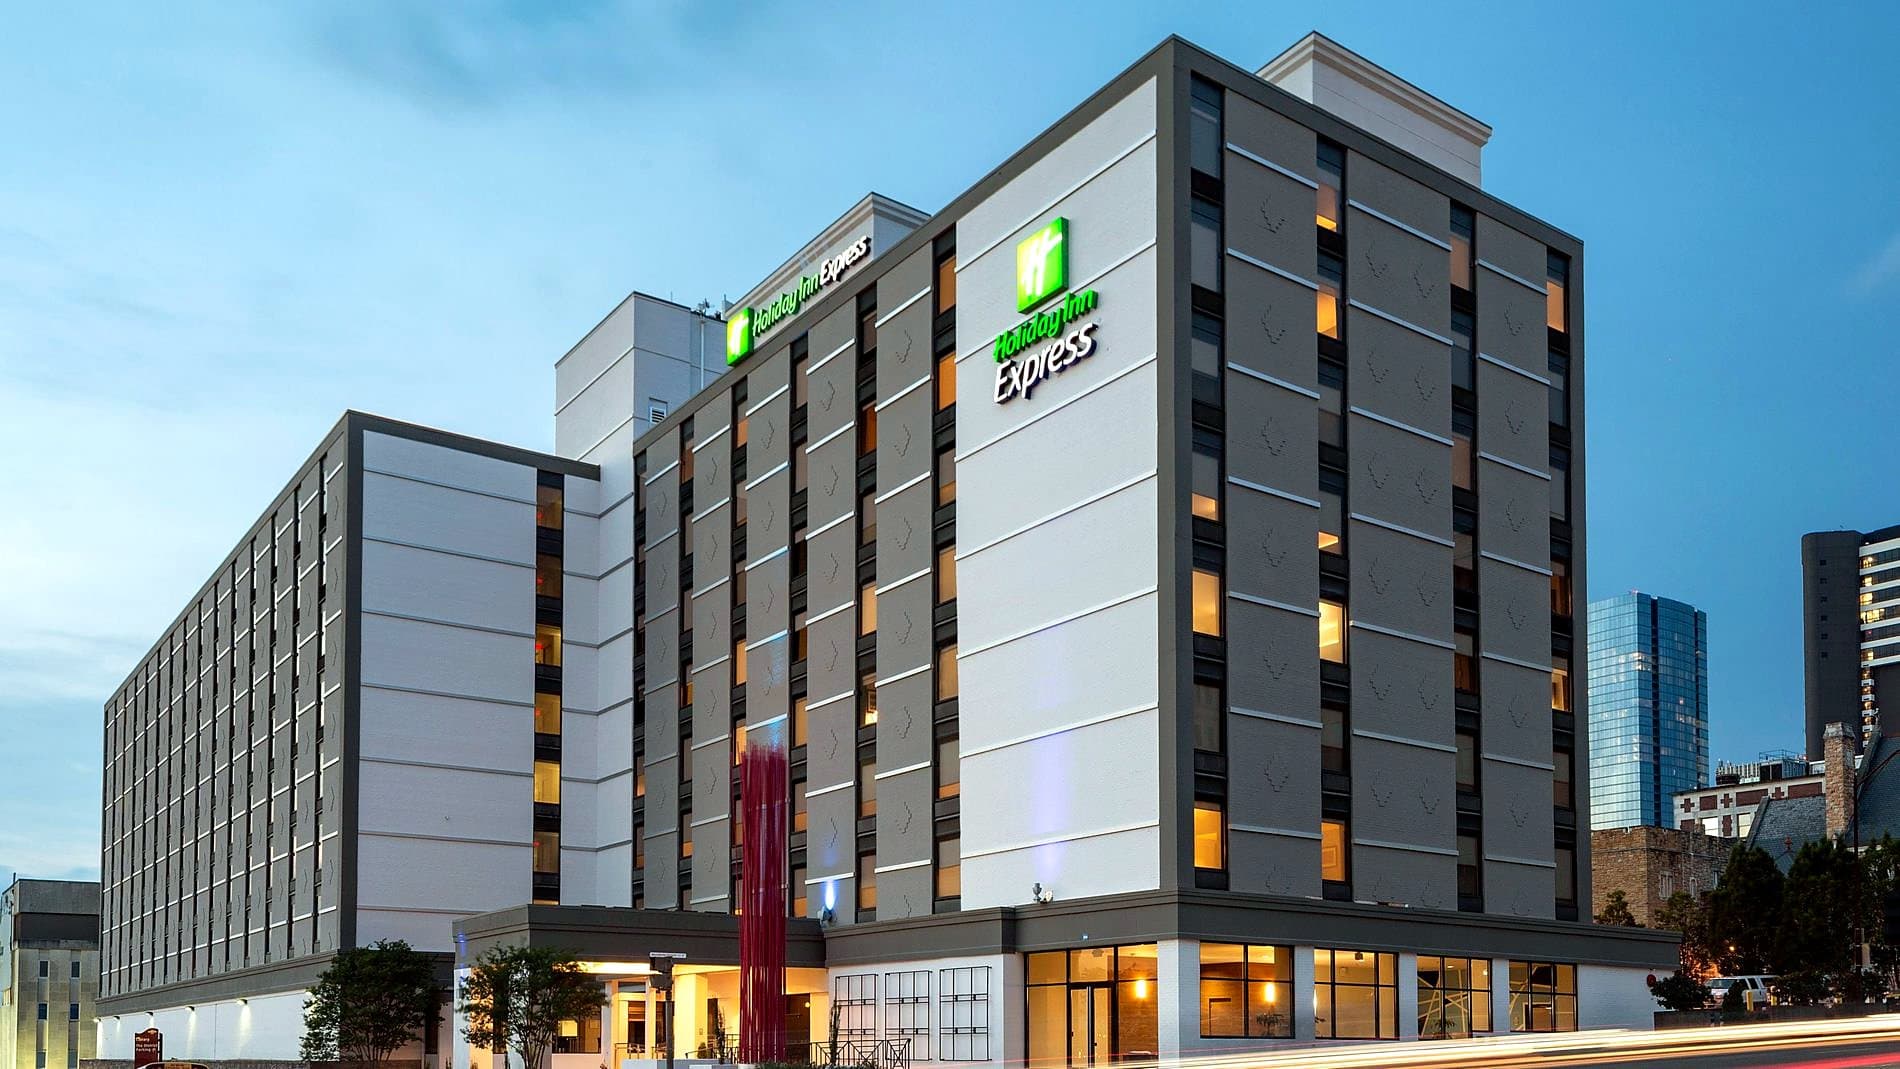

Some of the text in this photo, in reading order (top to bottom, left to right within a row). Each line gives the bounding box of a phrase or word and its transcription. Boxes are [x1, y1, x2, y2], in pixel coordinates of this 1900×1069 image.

[752, 235, 870, 337] Holiday Inn Express
[993, 288, 1097, 362] Holiday Inn
[993, 322, 1097, 403] Express
